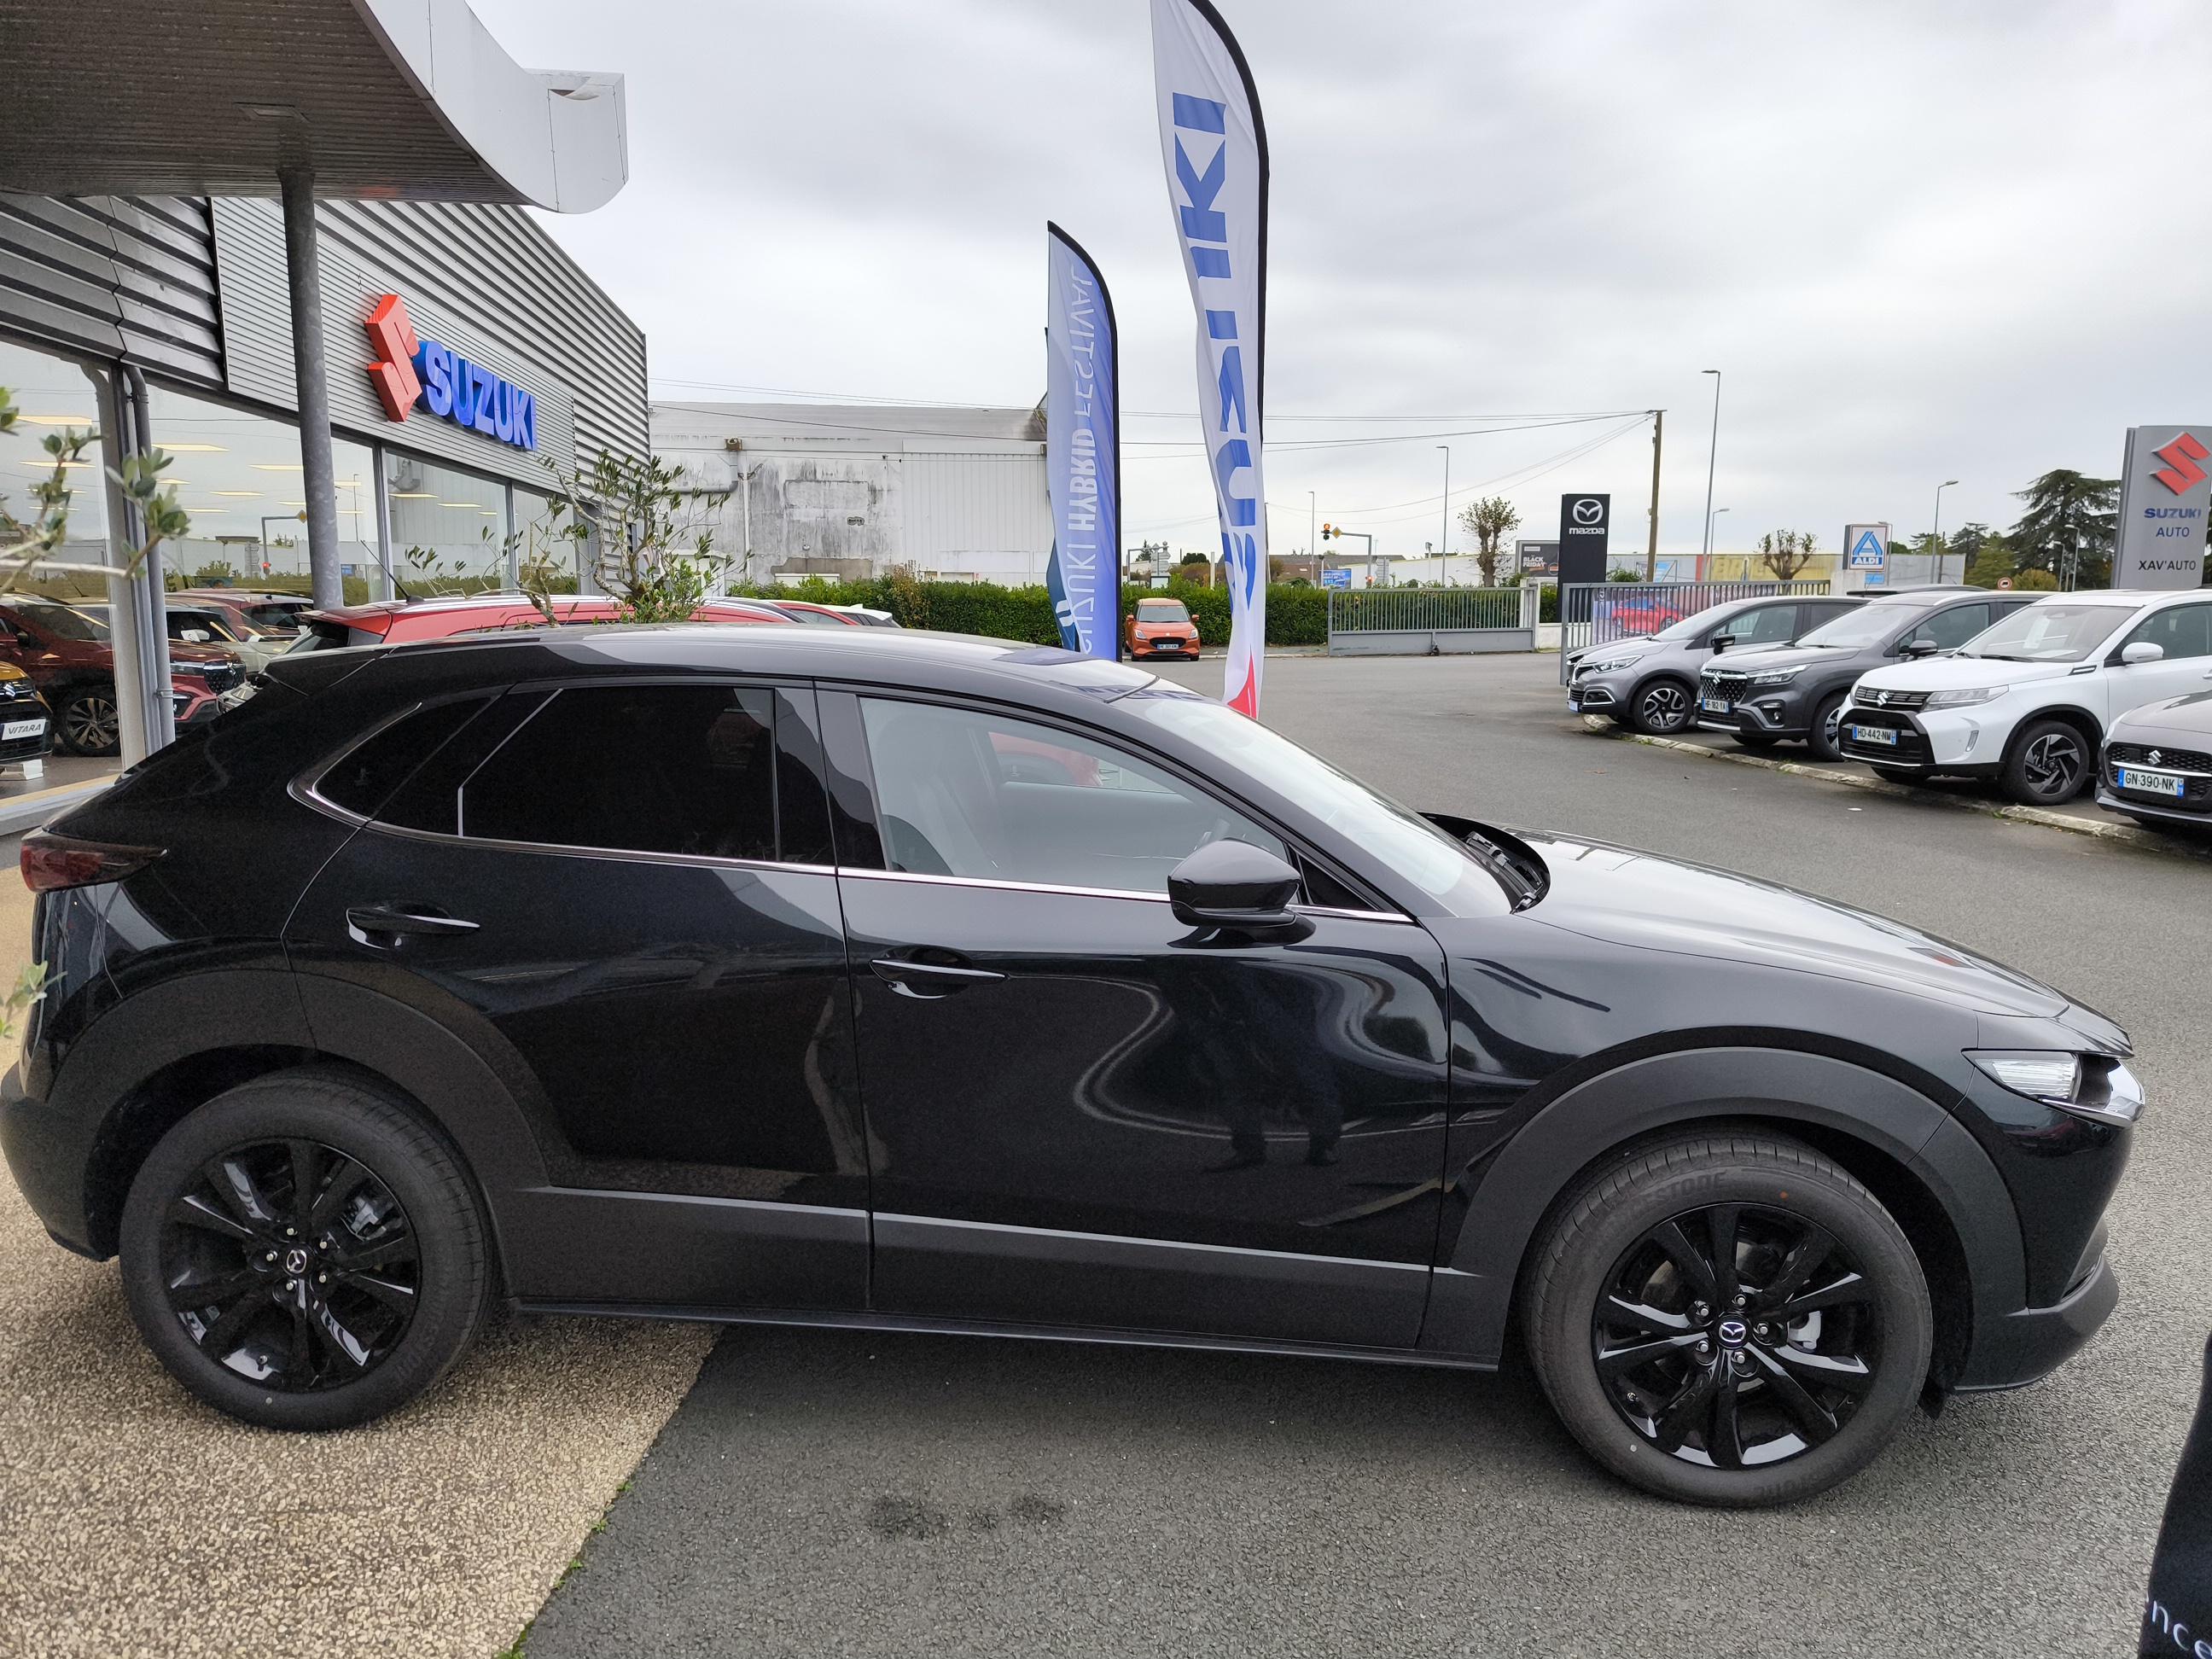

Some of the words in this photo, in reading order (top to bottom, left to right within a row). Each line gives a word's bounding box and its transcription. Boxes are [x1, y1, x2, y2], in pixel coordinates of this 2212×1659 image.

[416, 341, 538, 451] SUZUKI
[2144, 508, 2202, 519] SUZUKI
[2156, 527, 2190, 538] AUTO
[1854, 556, 1880, 565] ALDI
[2139, 560, 2197, 571] XAV'AUTO
[9, 724, 41, 735] VITARA
[2125, 772, 2175, 791] GN-390-NK
